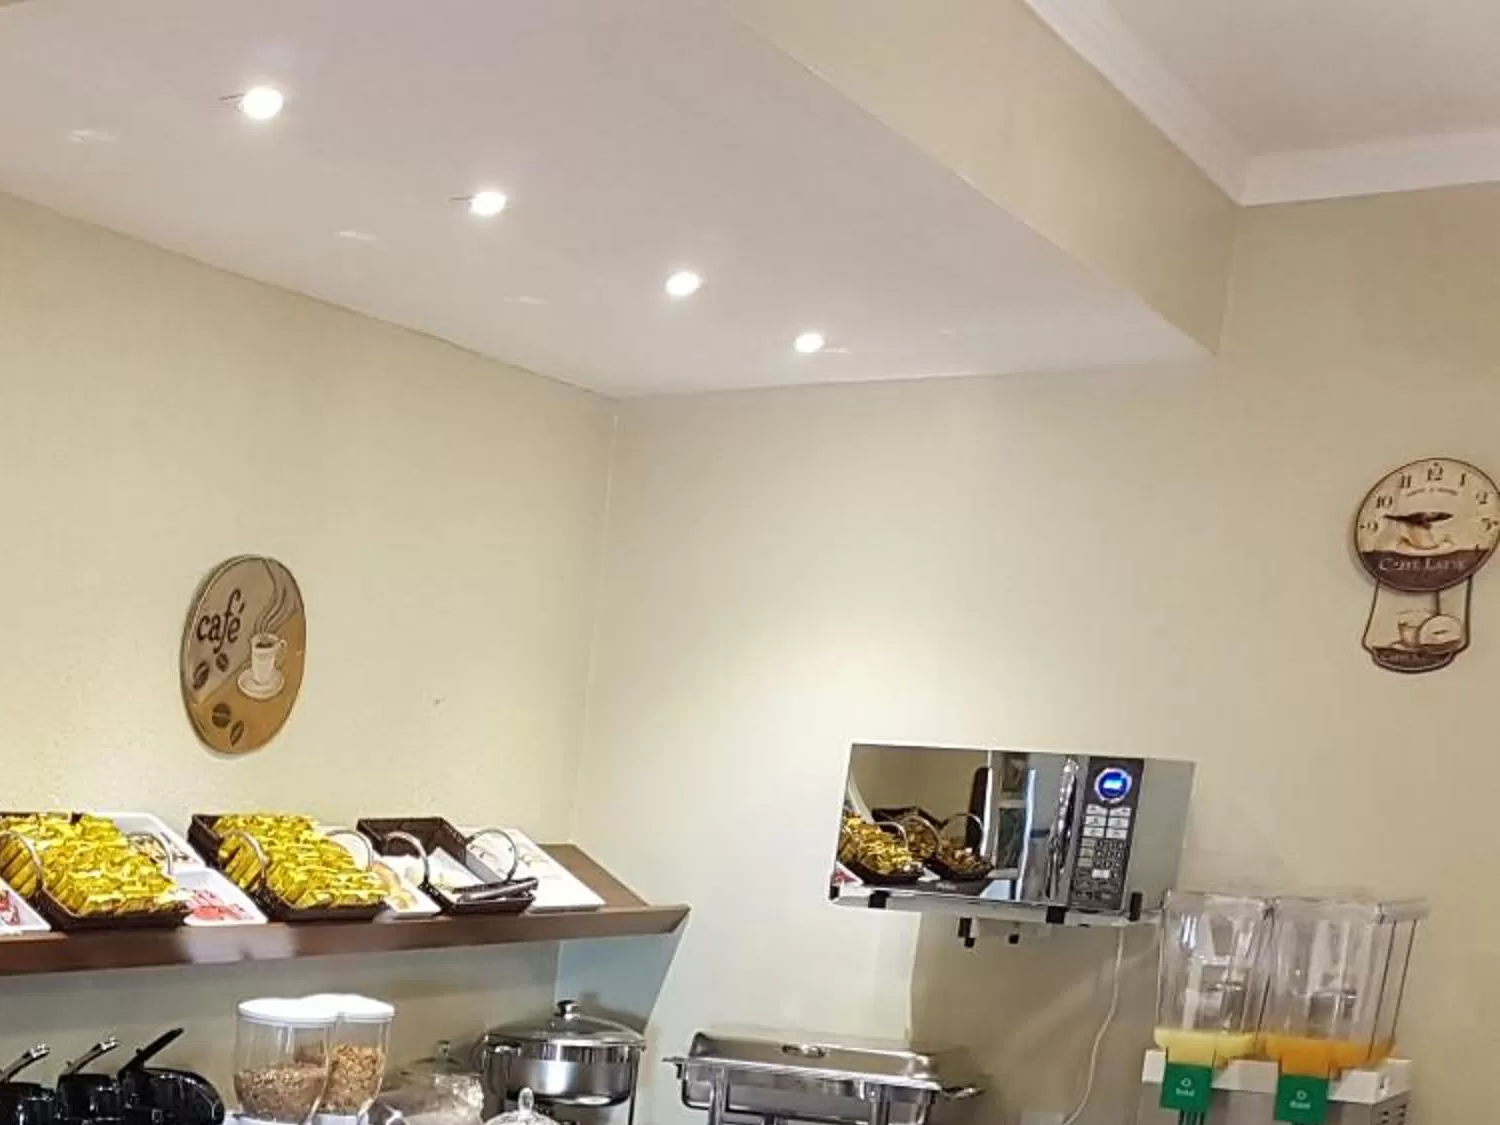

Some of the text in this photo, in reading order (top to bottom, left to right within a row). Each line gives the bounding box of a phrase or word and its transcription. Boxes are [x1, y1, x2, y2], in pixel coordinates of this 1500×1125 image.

[1400, 474, 1412, 489] 11
[1426, 468, 1444, 482] 12
[1376, 495, 1393, 509] 10
[197, 588, 245, 654] café
